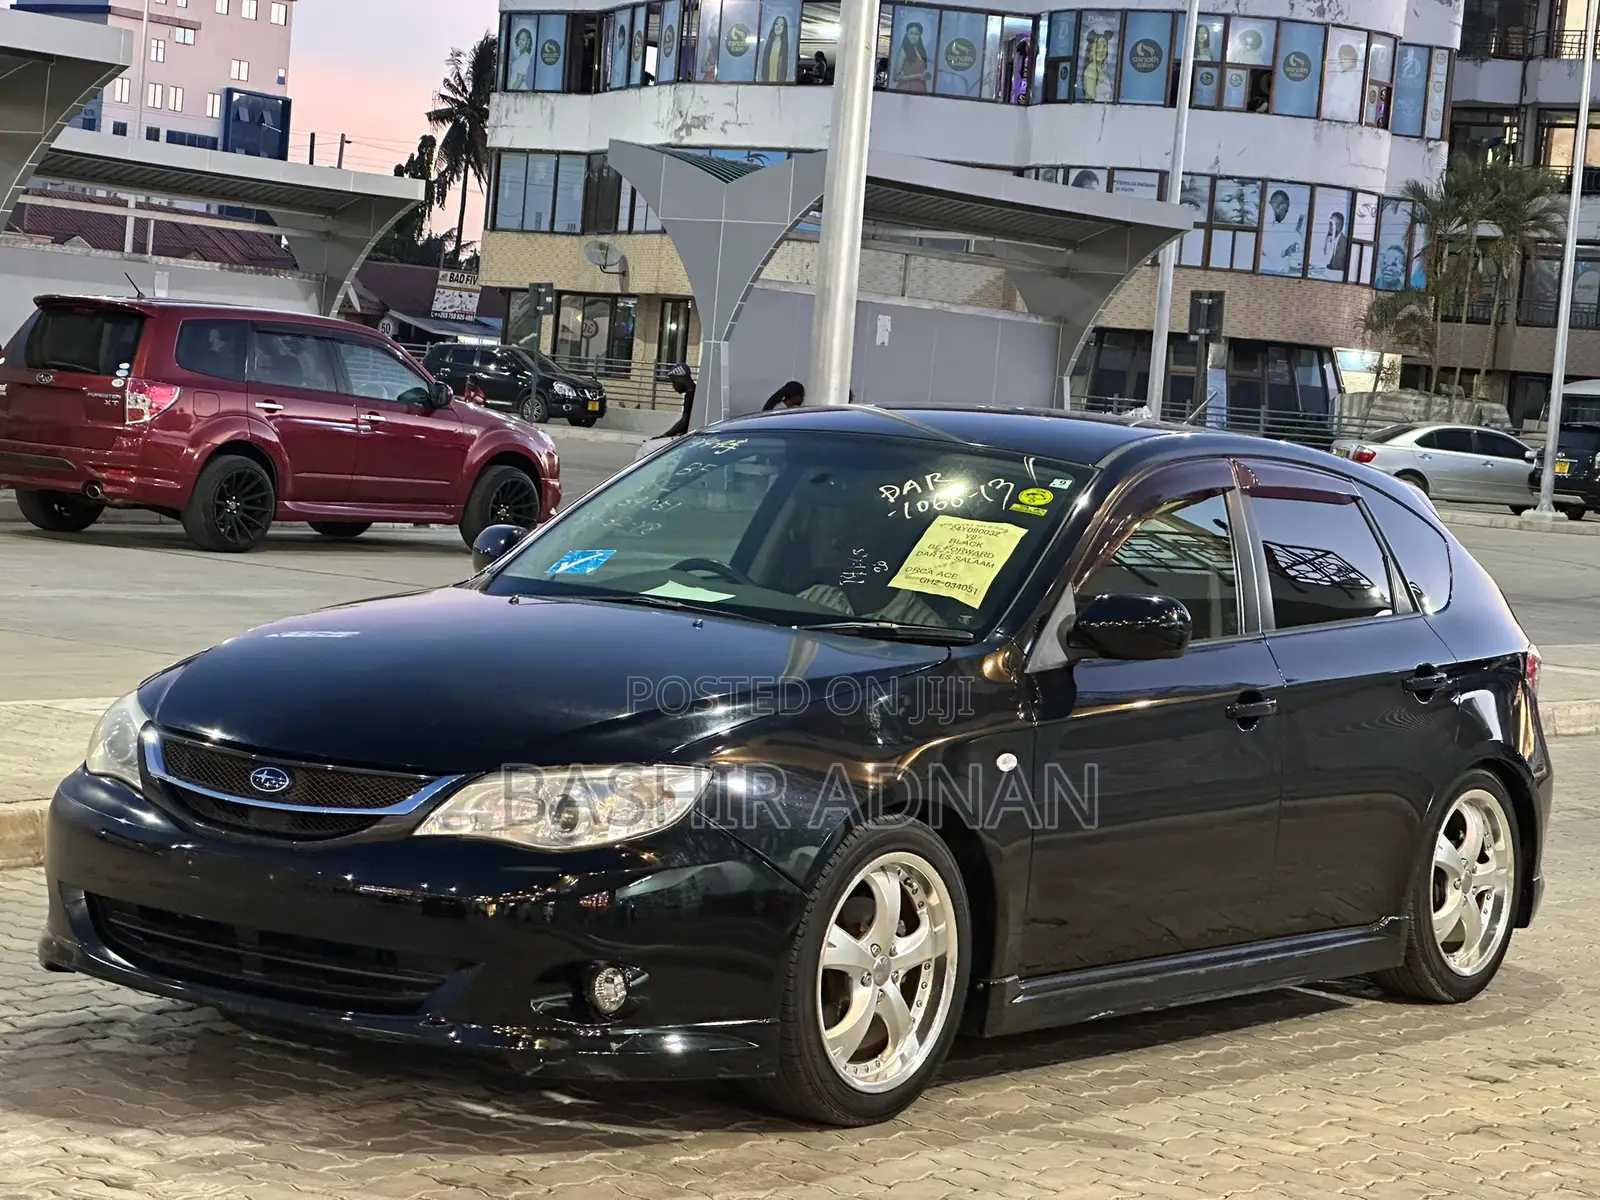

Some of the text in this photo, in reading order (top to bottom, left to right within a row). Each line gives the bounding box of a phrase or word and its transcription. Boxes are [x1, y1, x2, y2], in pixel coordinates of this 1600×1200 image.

[449, 273, 465, 284] BAD
[381, 322, 391, 334] 50
[879, 472, 954, 502] DAR
[948, 538, 985, 548] BLACK
[927, 543, 995, 559] BE FORWARD
[915, 551, 936, 559] DAR
[953, 555, 995, 569] SALAAM
[935, 571, 960, 580] ACE
